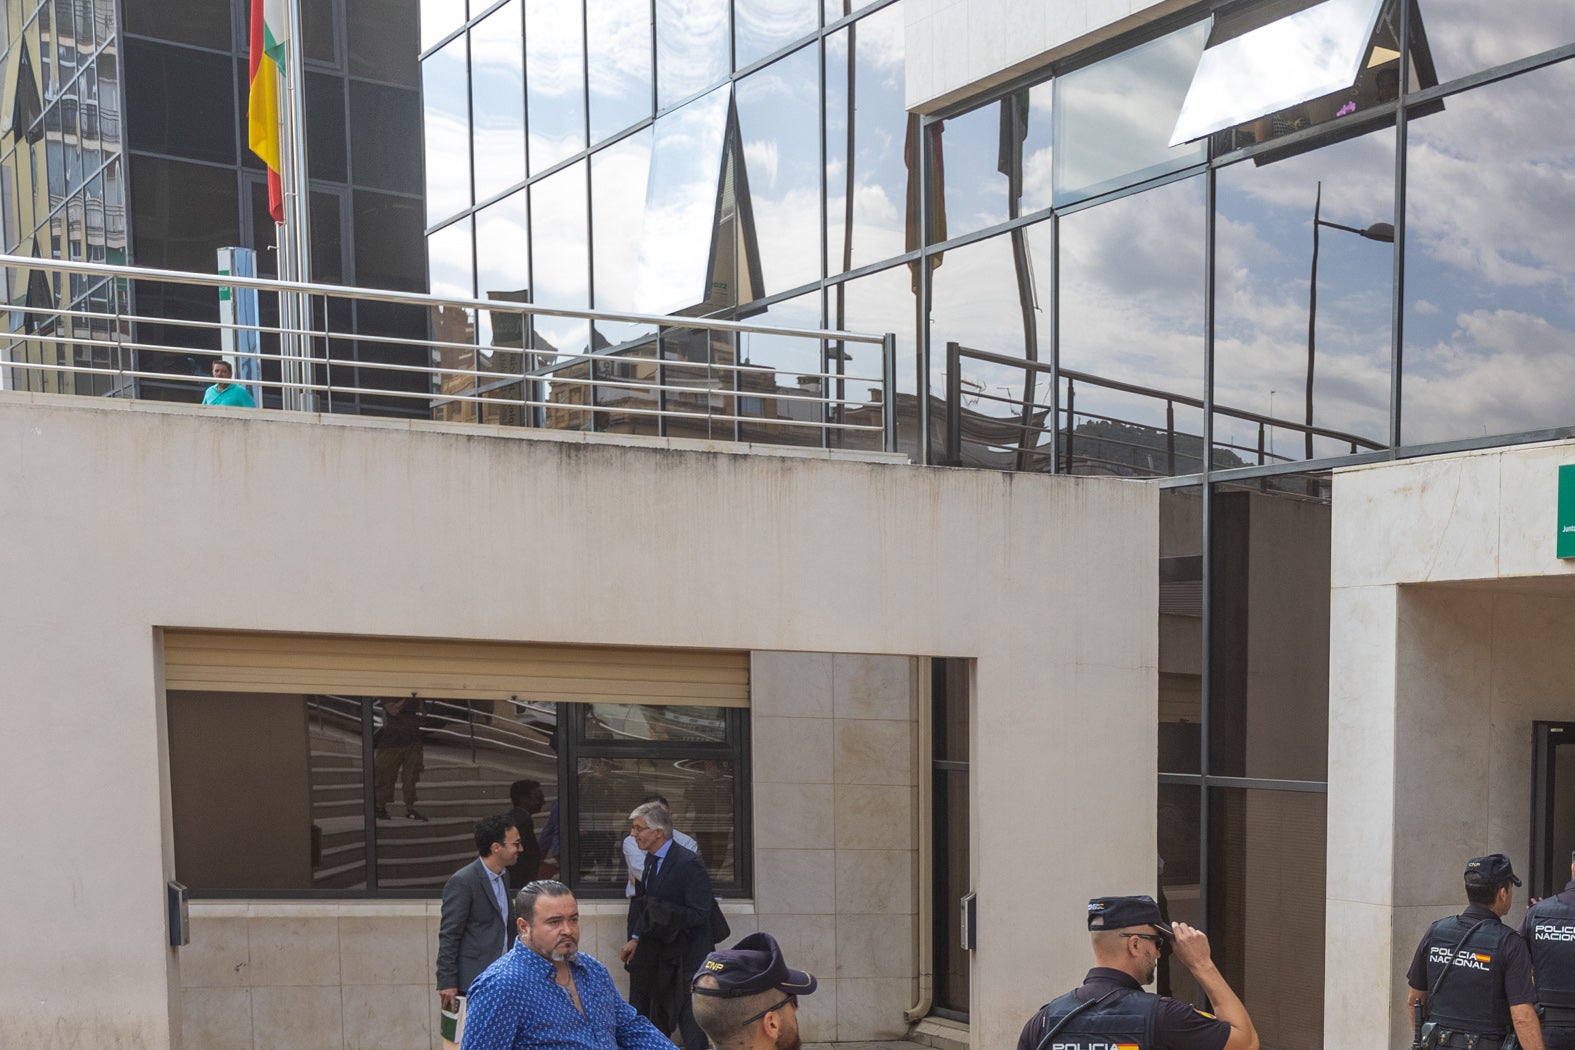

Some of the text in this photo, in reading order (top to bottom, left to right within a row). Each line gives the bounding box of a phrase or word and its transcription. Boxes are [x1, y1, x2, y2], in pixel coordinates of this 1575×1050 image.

[1562, 525, 1575, 533] Junta
[1430, 946, 1477, 960] POLCIA
[705, 960, 724, 971] CNP
